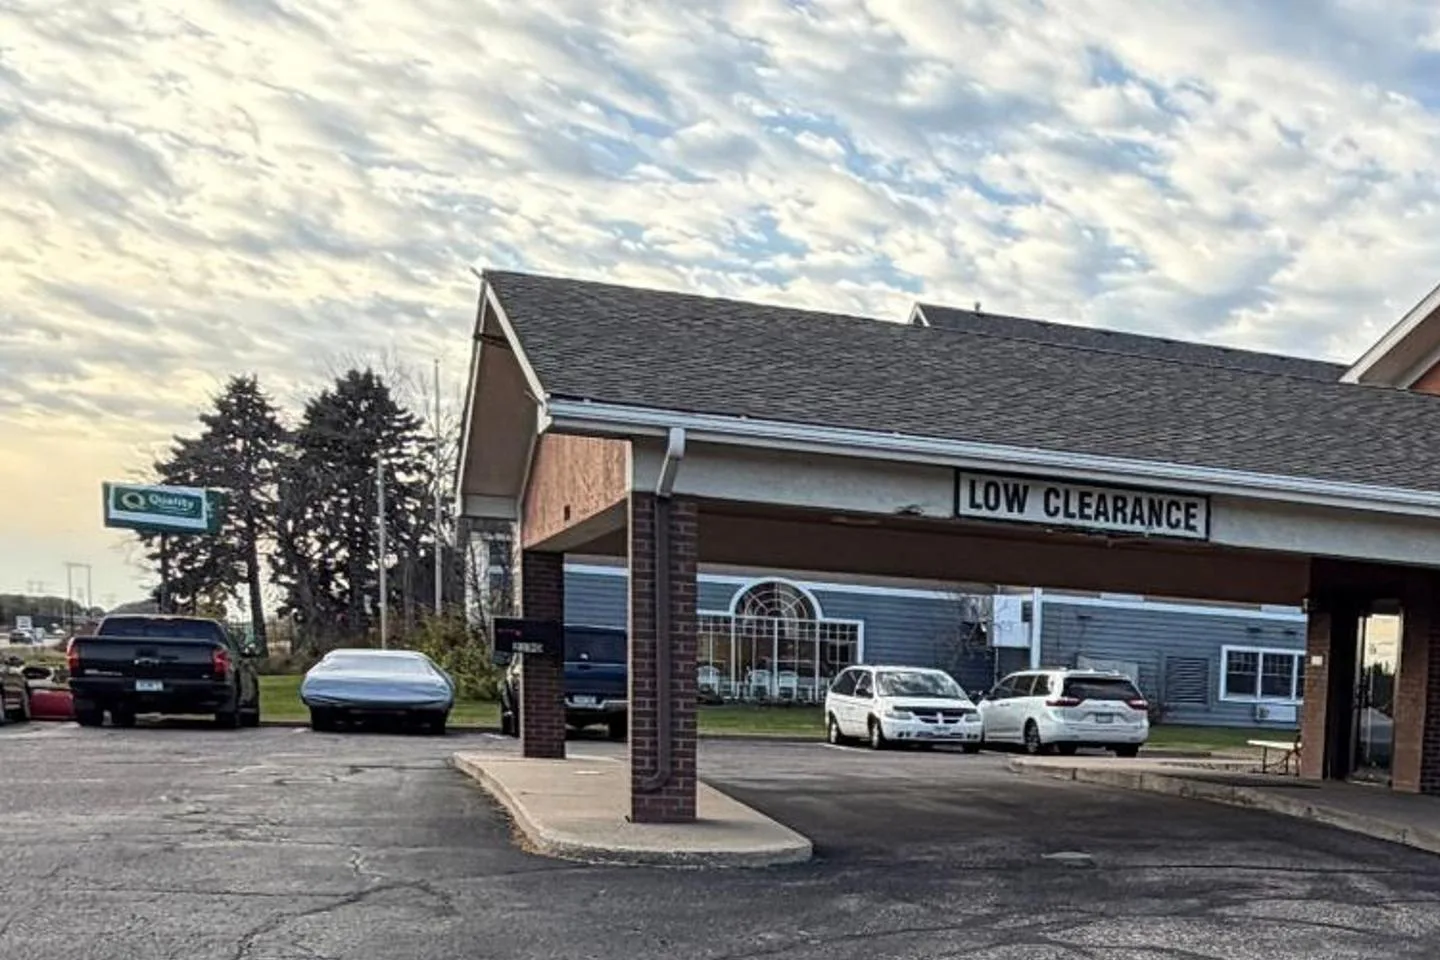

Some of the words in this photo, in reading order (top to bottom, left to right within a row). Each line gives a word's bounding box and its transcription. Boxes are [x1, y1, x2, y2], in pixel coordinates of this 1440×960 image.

[149, 493, 194, 510] Quality
[969, 479, 1029, 513] LOW
[1044, 487, 1199, 532] CLEARANCE
